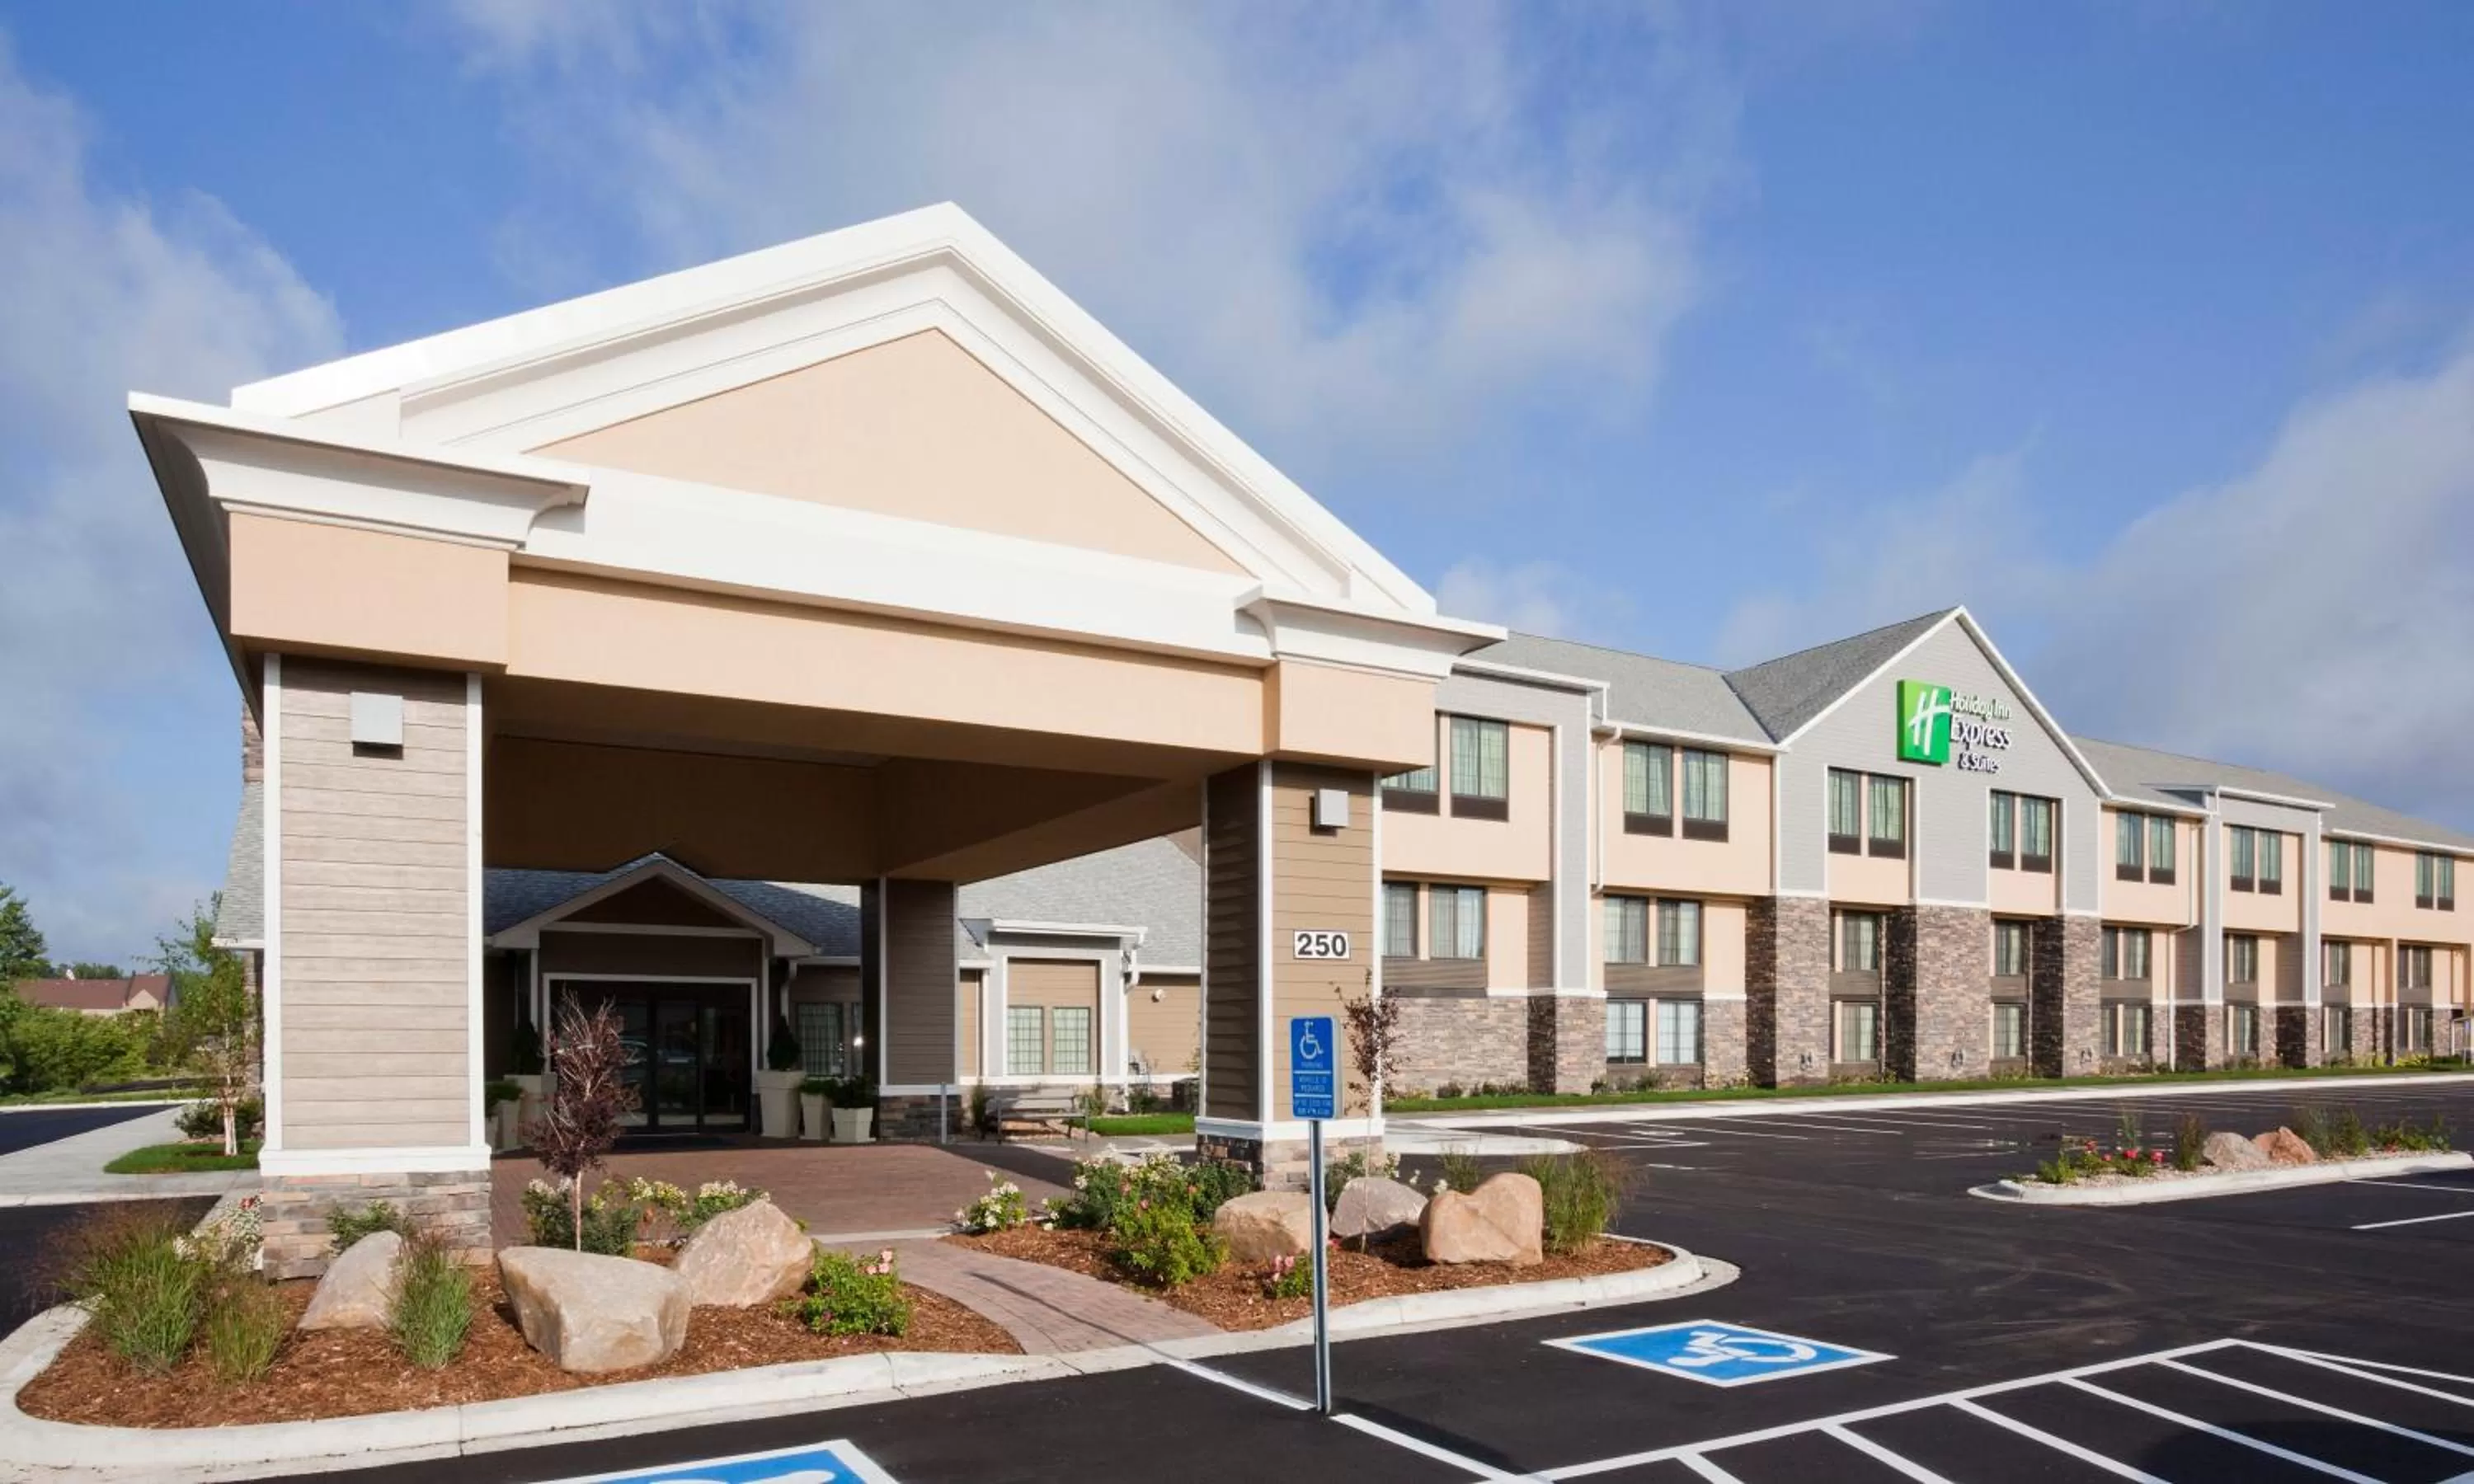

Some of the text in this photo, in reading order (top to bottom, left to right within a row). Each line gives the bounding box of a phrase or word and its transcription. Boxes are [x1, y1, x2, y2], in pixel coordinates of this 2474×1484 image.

[1951, 691, 2011, 720] Holiday Inn
[1950, 712, 2012, 749] Express
[1959, 751, 1970, 768] &
[1297, 933, 1347, 956] 250
